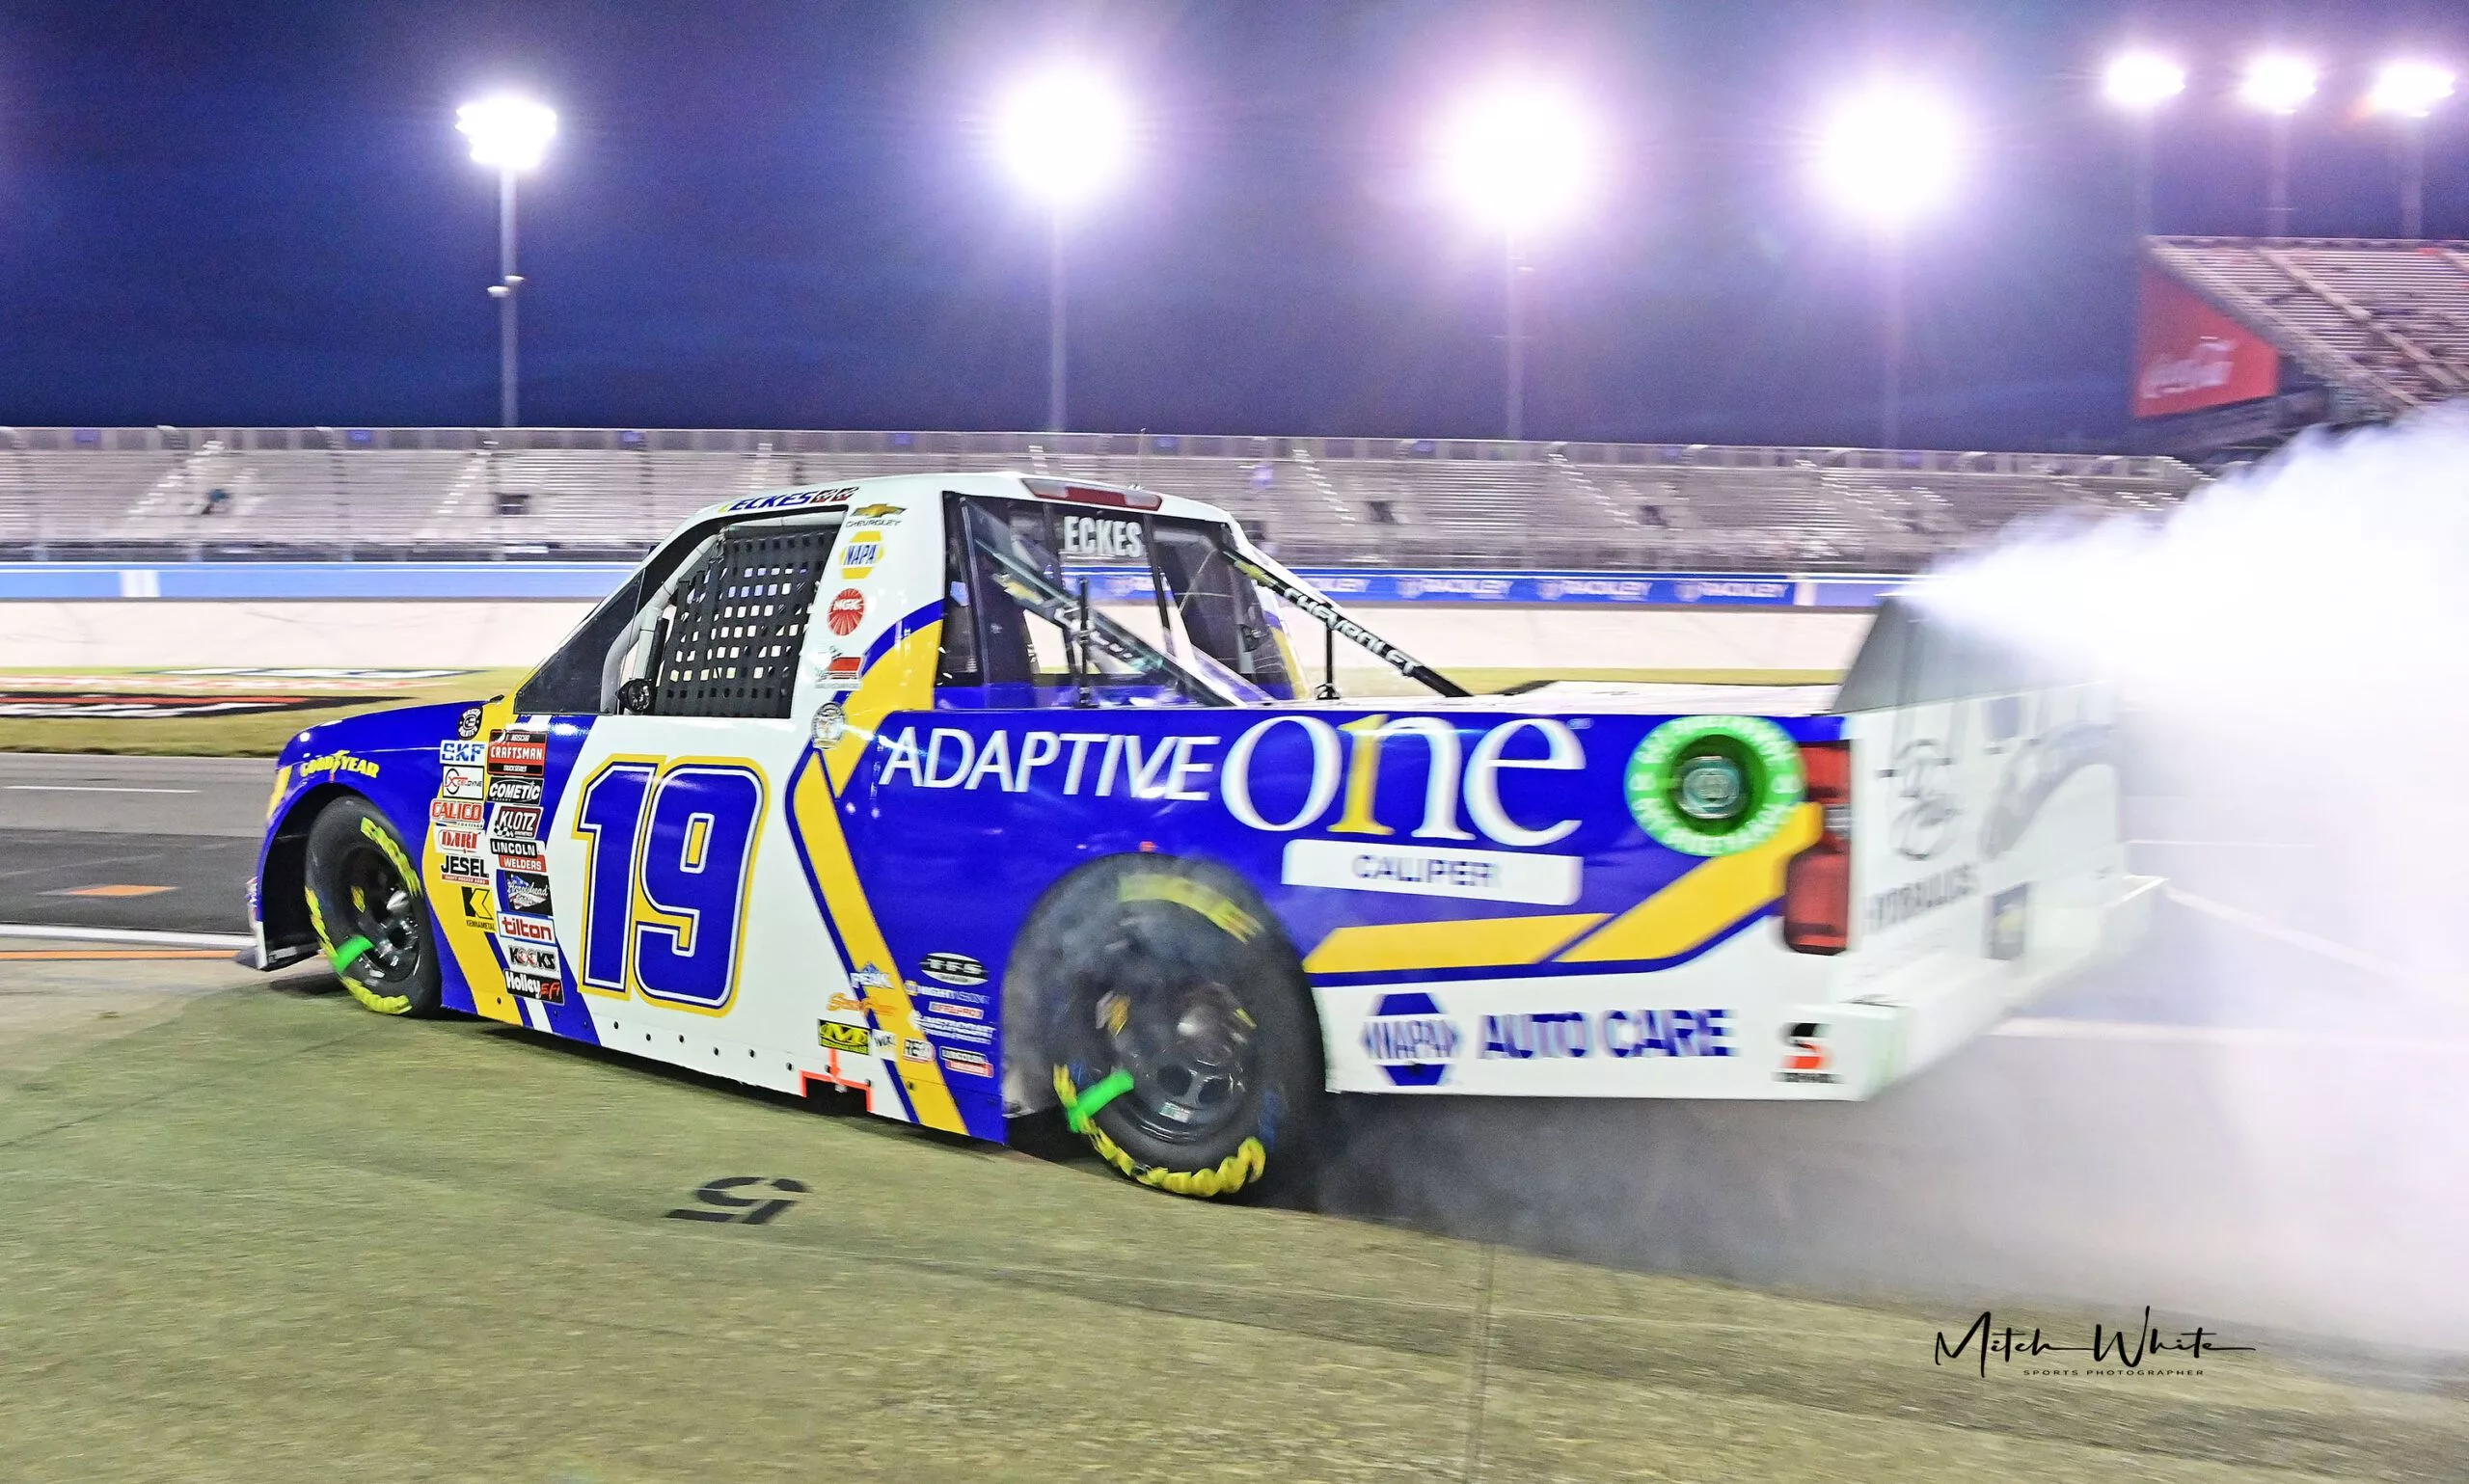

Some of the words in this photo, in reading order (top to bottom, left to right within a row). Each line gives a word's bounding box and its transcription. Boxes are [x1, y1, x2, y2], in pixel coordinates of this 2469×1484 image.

[729, 490, 819, 512] ECKES
[1064, 516, 1145, 557] ECKES
[844, 544, 879, 565] NAPA
[832, 598, 861, 611] NGK
[441, 742, 485, 762] SKF
[490, 745, 543, 761] CRAFTSMAN
[879, 725, 1221, 801] ADAPTIVE
[300, 749, 380, 779] GOODYEAR
[489, 782, 541, 800] COMETIC
[431, 801, 483, 822] CALICO
[499, 810, 538, 830] KLOTZ
[491, 840, 536, 856] LINCOLN
[441, 854, 489, 878] JESEL
[503, 856, 542, 871] WELDERS
[1351, 853, 1500, 889] CALIPER
[571, 753, 772, 1018] 19
[502, 916, 553, 941] tilton
[509, 946, 556, 970] KOOKS
[504, 970, 541, 999] Holley
[1363, 1018, 1460, 1060] NAPA
[1477, 1011, 1591, 1060] AUTO
[1603, 1008, 1739, 1059] CARE
